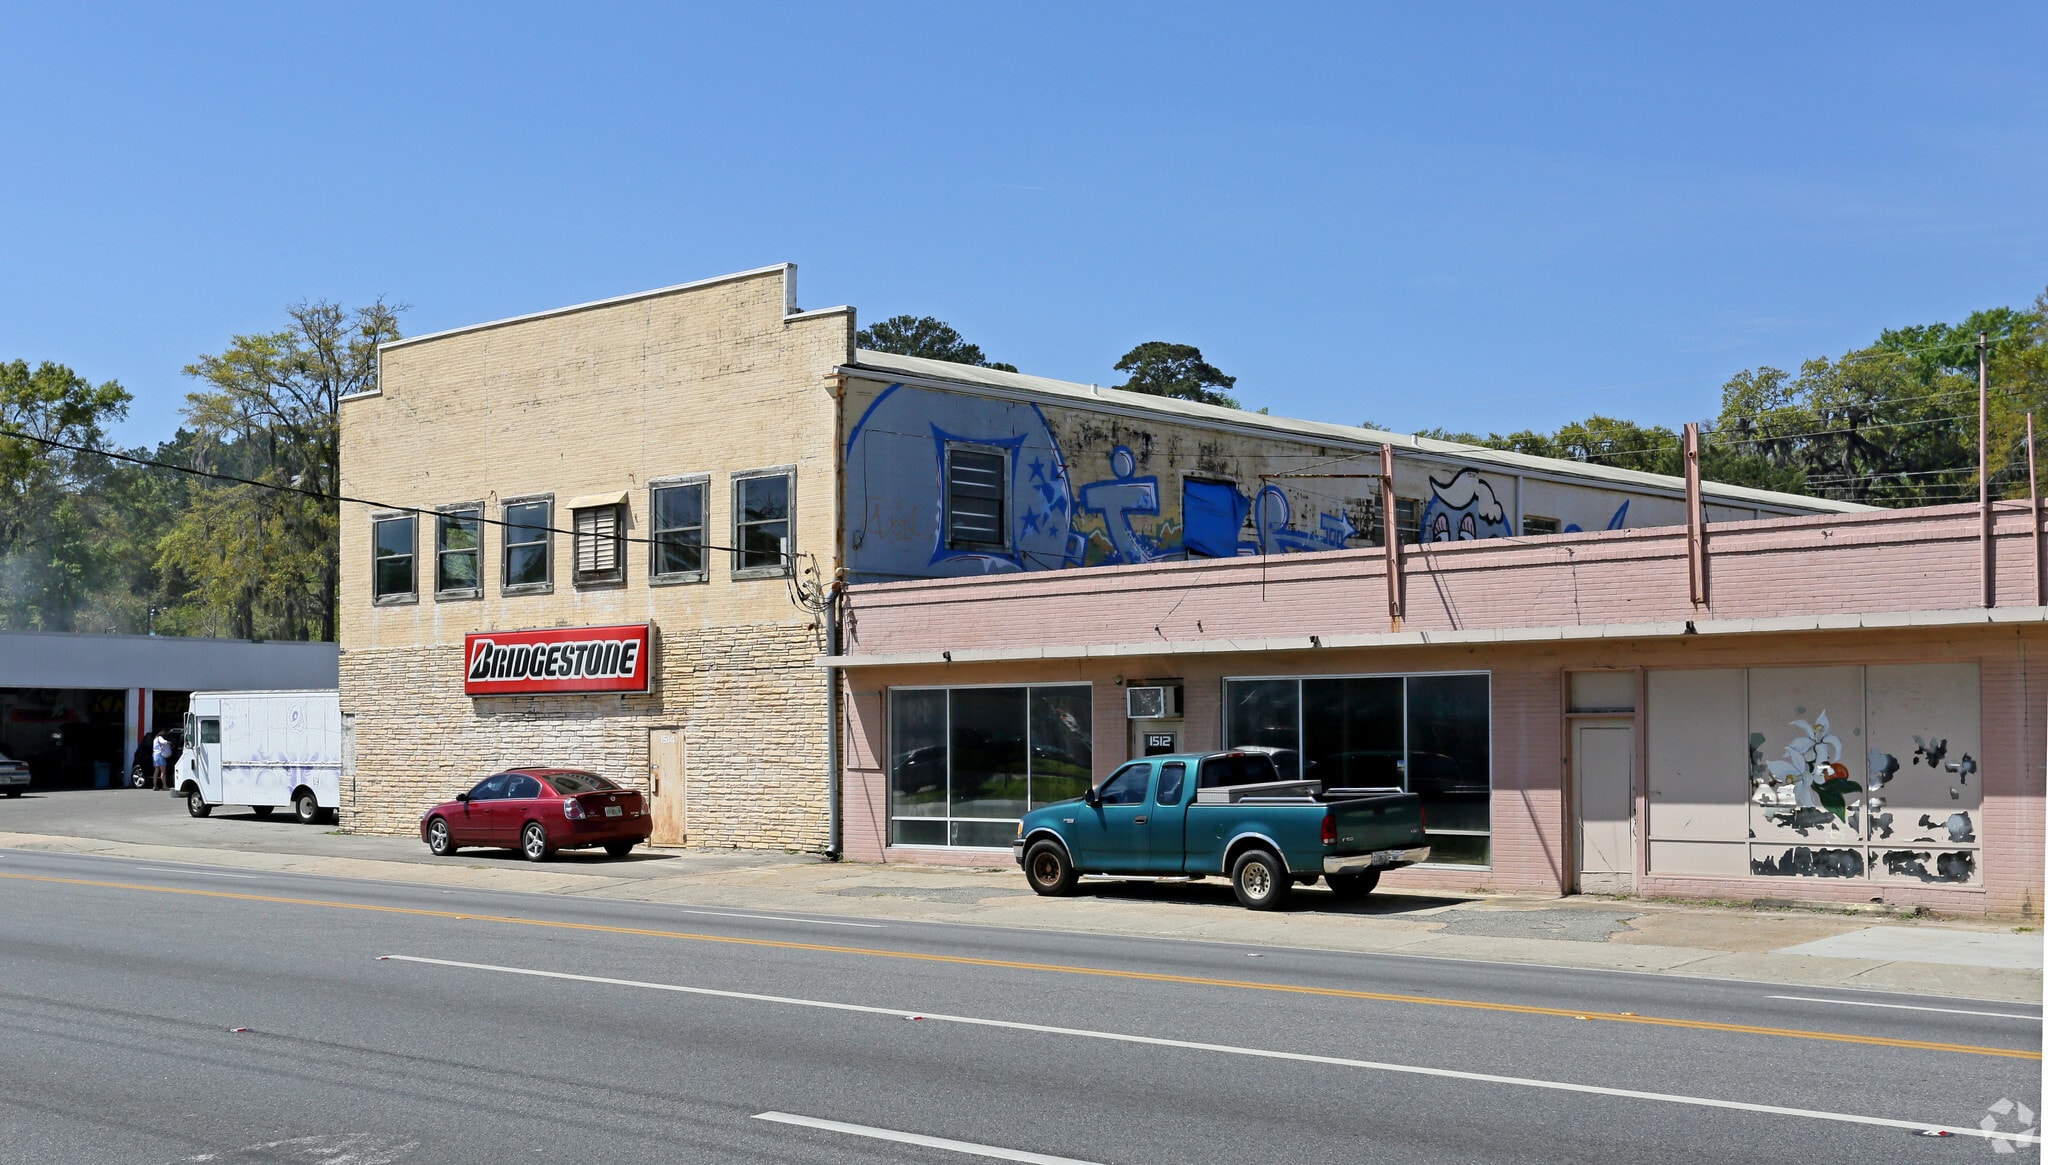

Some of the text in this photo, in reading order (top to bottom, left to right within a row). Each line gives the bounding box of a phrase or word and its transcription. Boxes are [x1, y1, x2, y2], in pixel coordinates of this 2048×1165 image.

[469, 641, 638, 680] BRIDGESTONE
[661, 735, 675, 744] 1514
[1150, 736, 1171, 746] 1512
